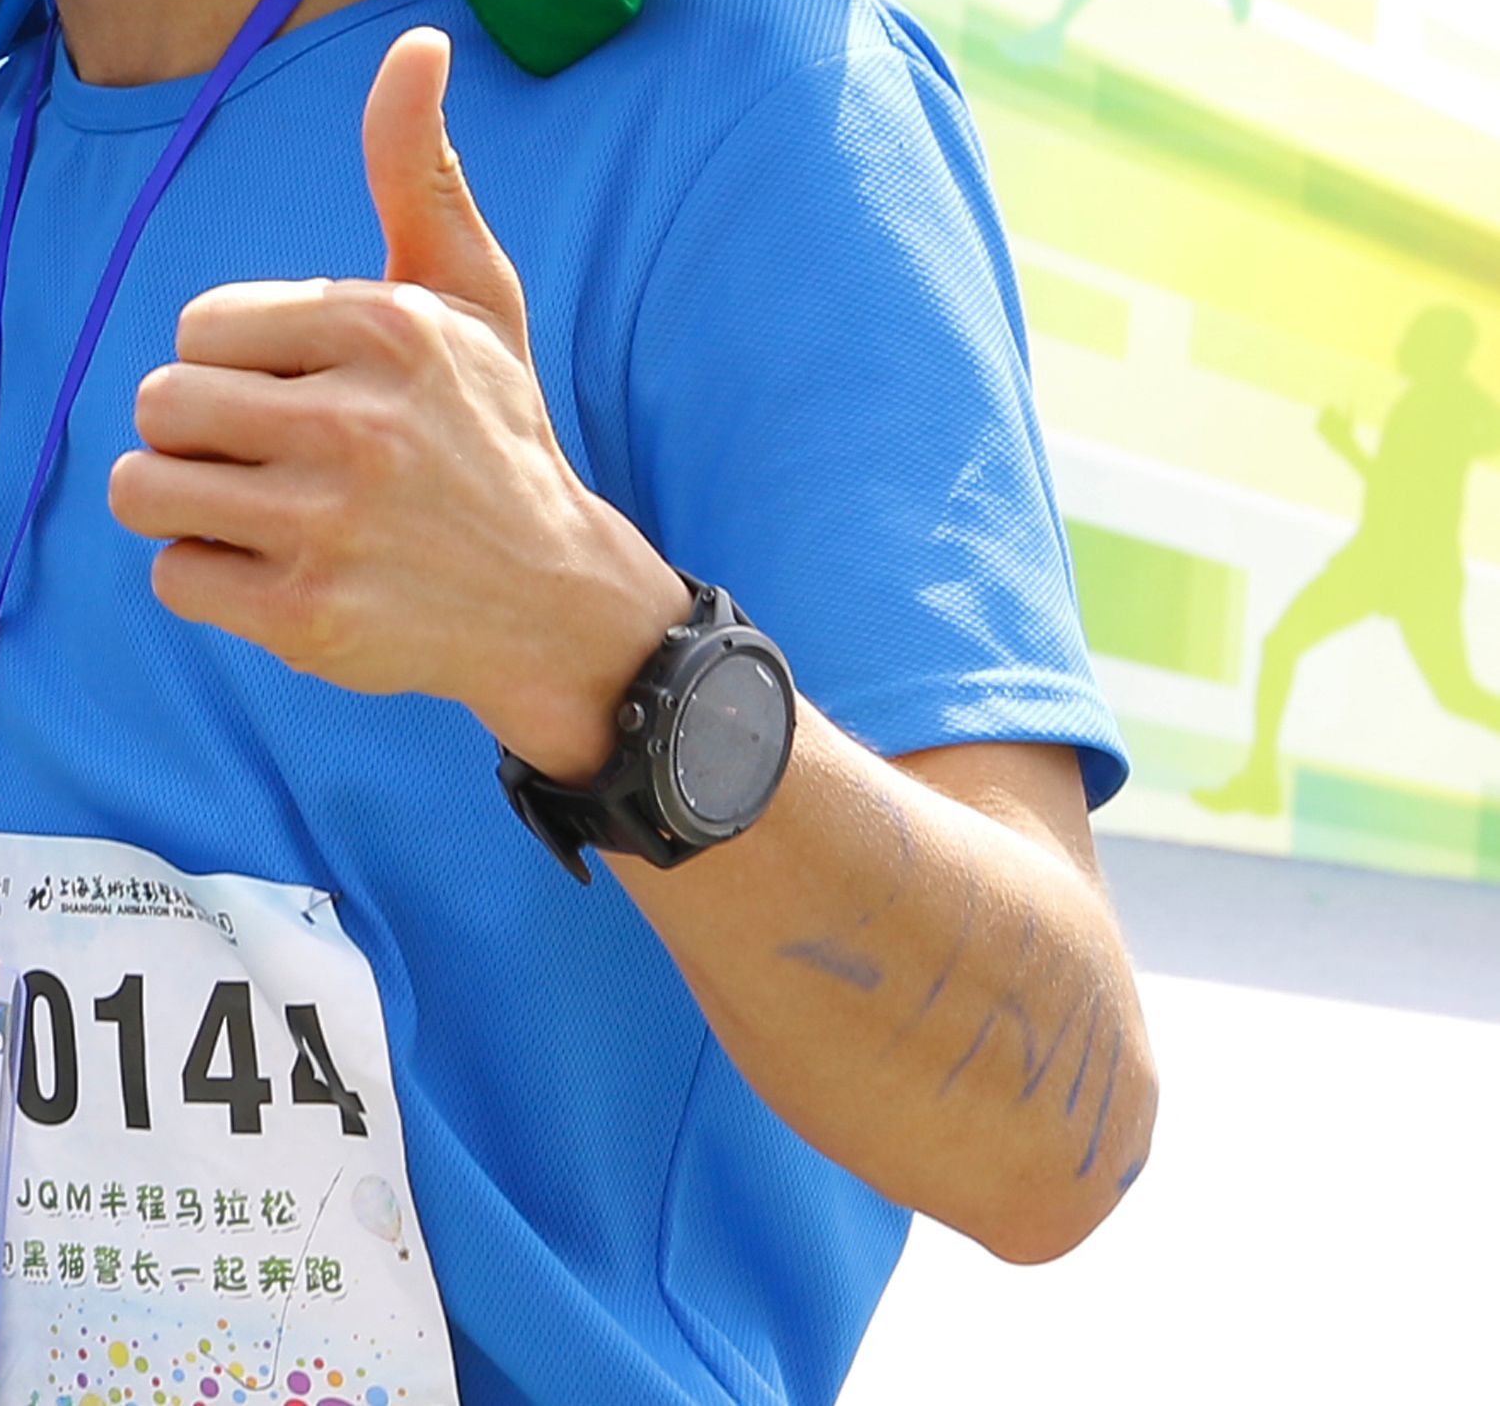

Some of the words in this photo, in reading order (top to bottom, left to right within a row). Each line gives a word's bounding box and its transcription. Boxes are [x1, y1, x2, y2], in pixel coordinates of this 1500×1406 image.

[15, 1177, 296, 1226] JQM半程马拉松
